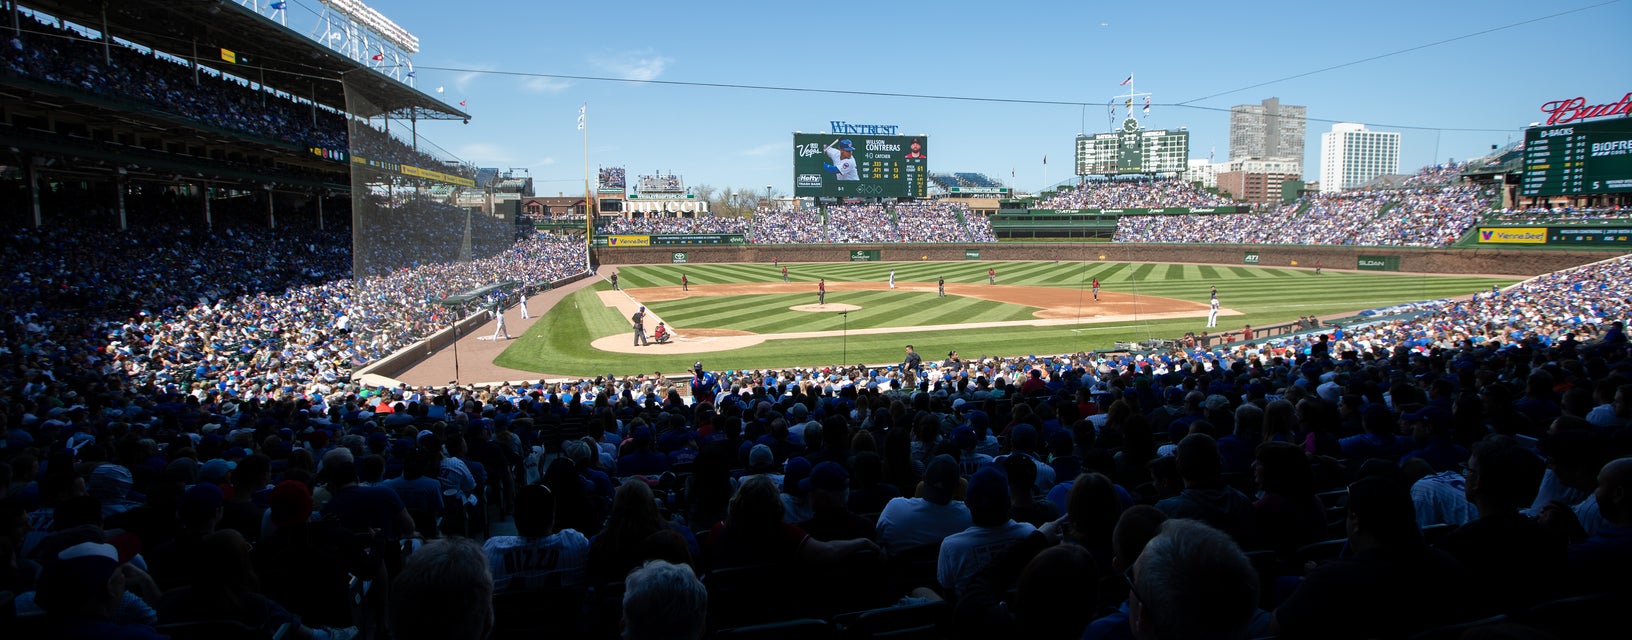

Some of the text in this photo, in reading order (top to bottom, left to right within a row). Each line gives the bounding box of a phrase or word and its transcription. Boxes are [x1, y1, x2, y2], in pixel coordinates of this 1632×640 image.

[831, 121, 898, 135] WINTRUST
[1541, 128, 1574, 138] D-BACKS
[796, 143, 822, 158] Vegas
[866, 144, 901, 152] CONTRERAS
[1592, 181, 1600, 190] 5
[622, 201, 708, 213] nuveen
[504, 549, 559, 574] RIZZO
